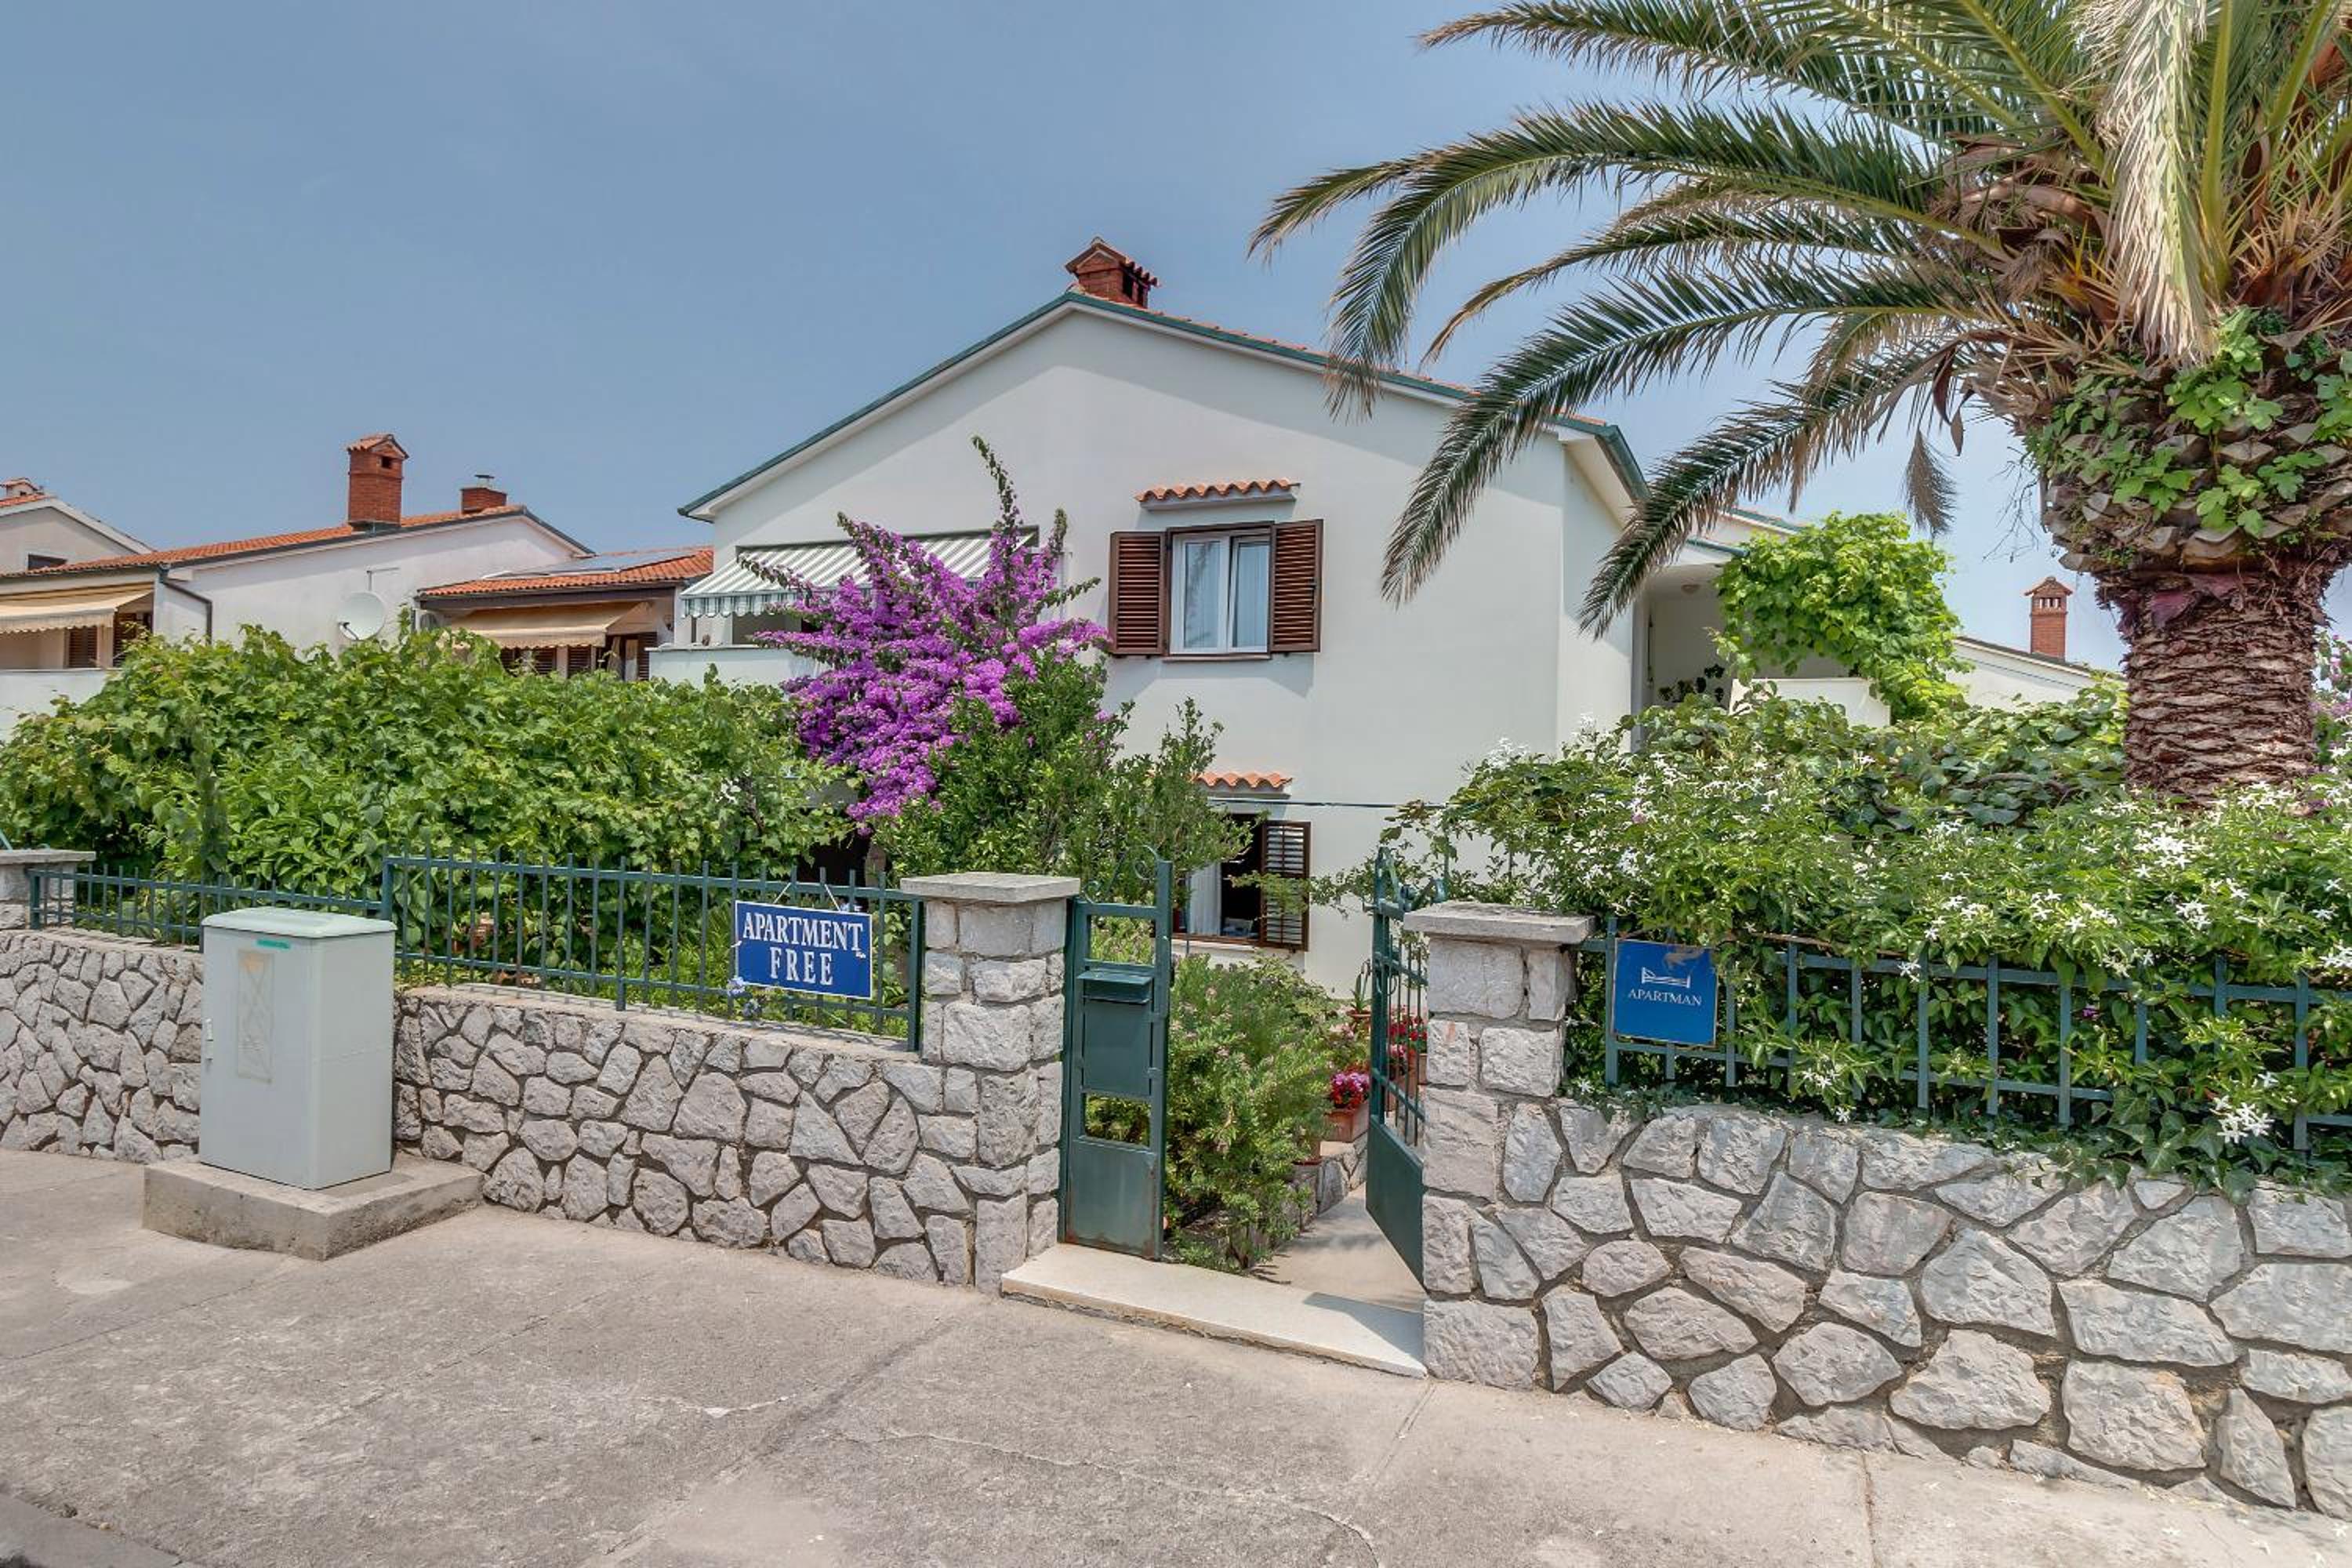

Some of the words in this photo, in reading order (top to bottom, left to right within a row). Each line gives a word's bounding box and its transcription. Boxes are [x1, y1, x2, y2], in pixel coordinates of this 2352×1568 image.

[743, 912, 862, 951] APARTMENT
[770, 946, 833, 985] FREE
[1628, 988, 1702, 1006] APARTMAN
